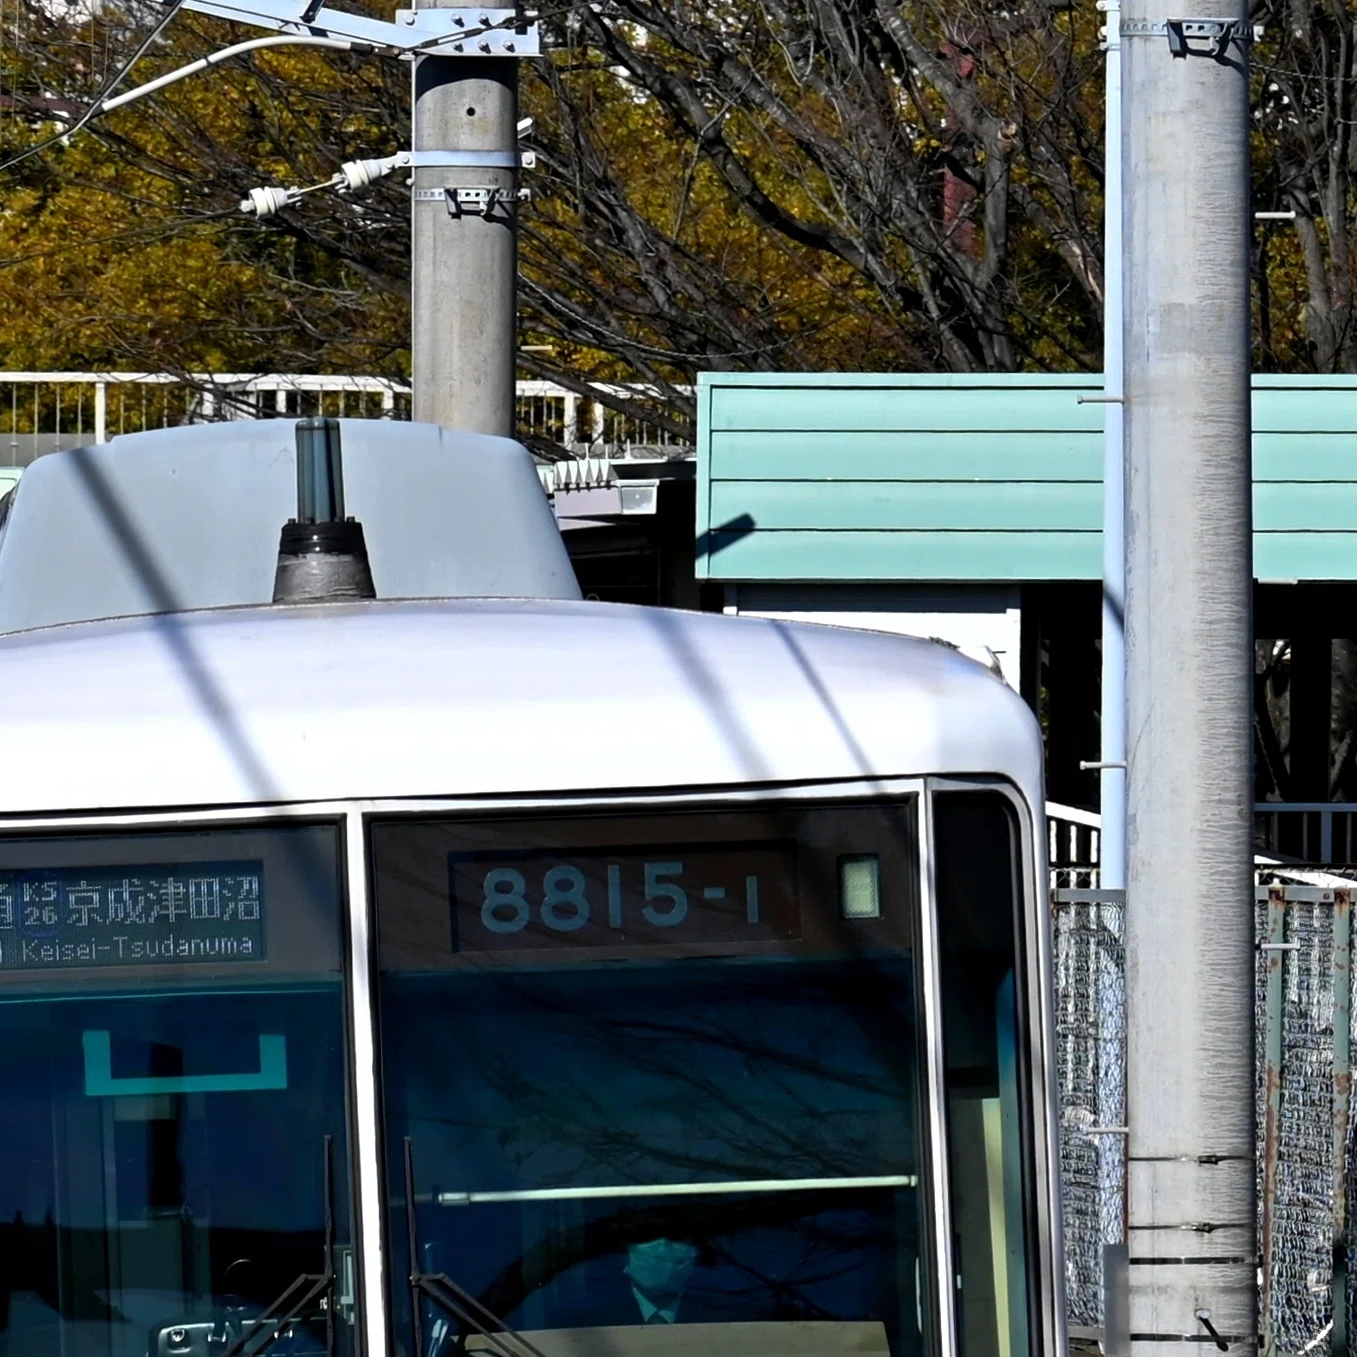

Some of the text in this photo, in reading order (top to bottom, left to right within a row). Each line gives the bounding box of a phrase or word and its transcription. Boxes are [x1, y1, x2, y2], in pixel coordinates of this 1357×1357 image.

[23, 881, 57, 902] KS
[65, 876, 260, 926] 京成津田沼
[480, 861, 759, 934] 8815-1
[25, 906, 58, 926] 26
[22, 934, 253, 962] Keisei-Tsudanuma
